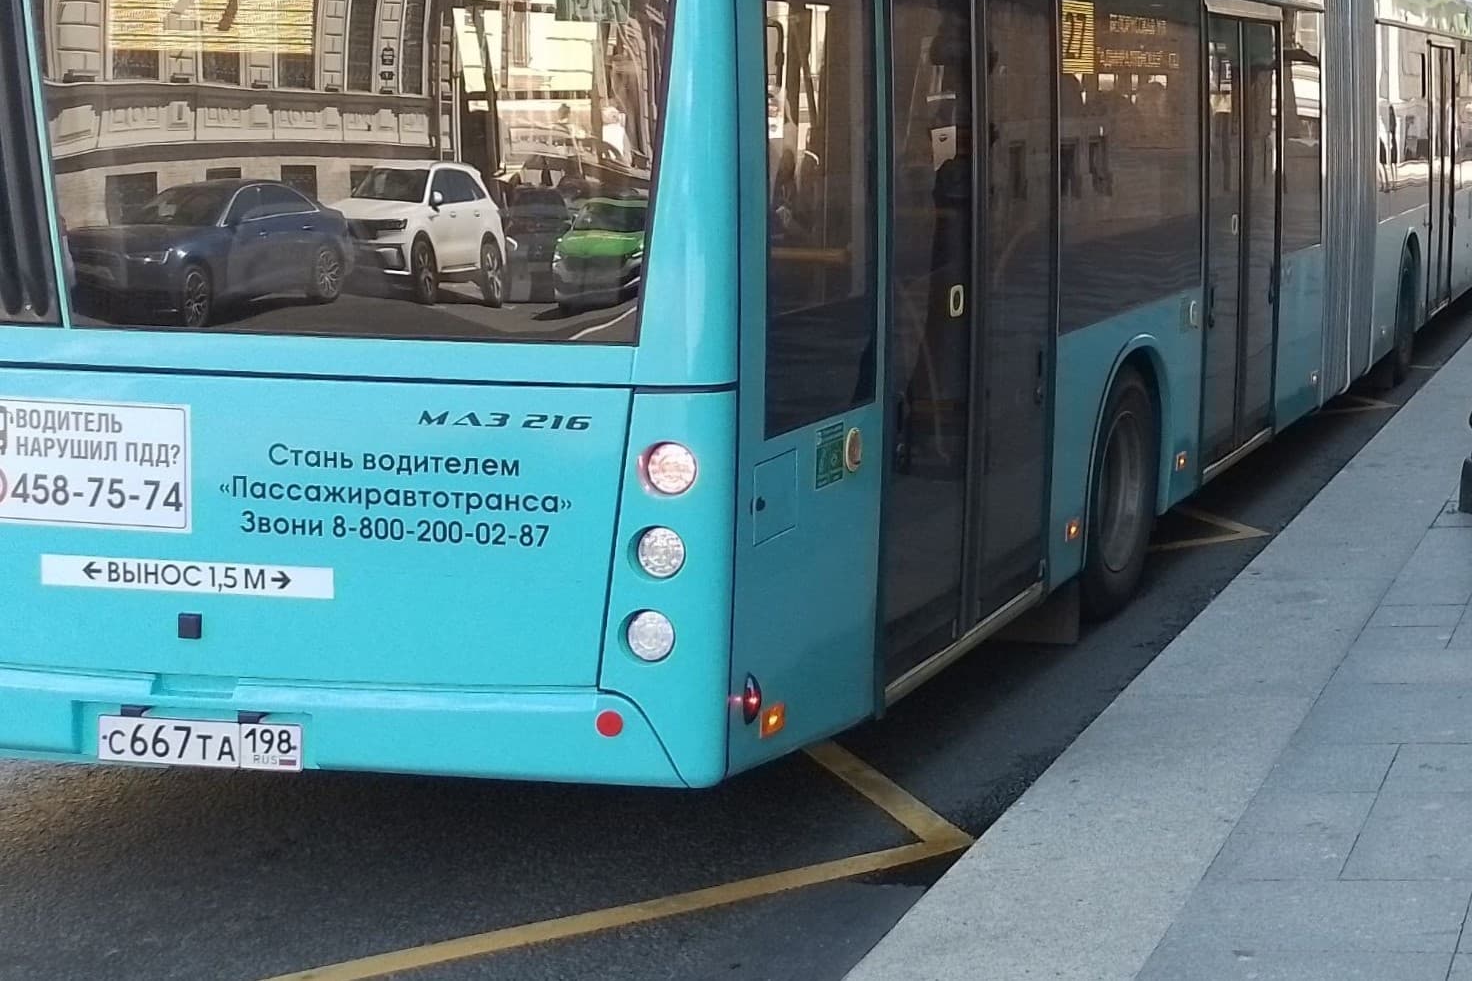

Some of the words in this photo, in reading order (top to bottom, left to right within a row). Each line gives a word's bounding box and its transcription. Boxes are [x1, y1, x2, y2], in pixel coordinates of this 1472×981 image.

[1064, 11, 1087, 60] 27
[16, 408, 123, 434] ВОДИТЕЛЬ
[418, 410, 511, 428] МАЗ
[521, 414, 592, 430] 216
[16, 436, 118, 461] НАРУШИЛ
[125, 442, 181, 467] ПДД?
[268, 443, 354, 469] Стань
[362, 453, 521, 477] водителем
[11, 473, 183, 512] 458-75-74
[219, 475, 573, 515] «Пассажиравтотранса»
[240, 510, 324, 537] Звони
[332, 515, 550, 548] 8-800-200-02-87
[107, 561, 203, 587] ВЫНОС
[208, 566, 238, 592] 1,5
[244, 568, 266, 590] М
[244, 727, 293, 754] 198
[253, 755, 278, 765] RUS
